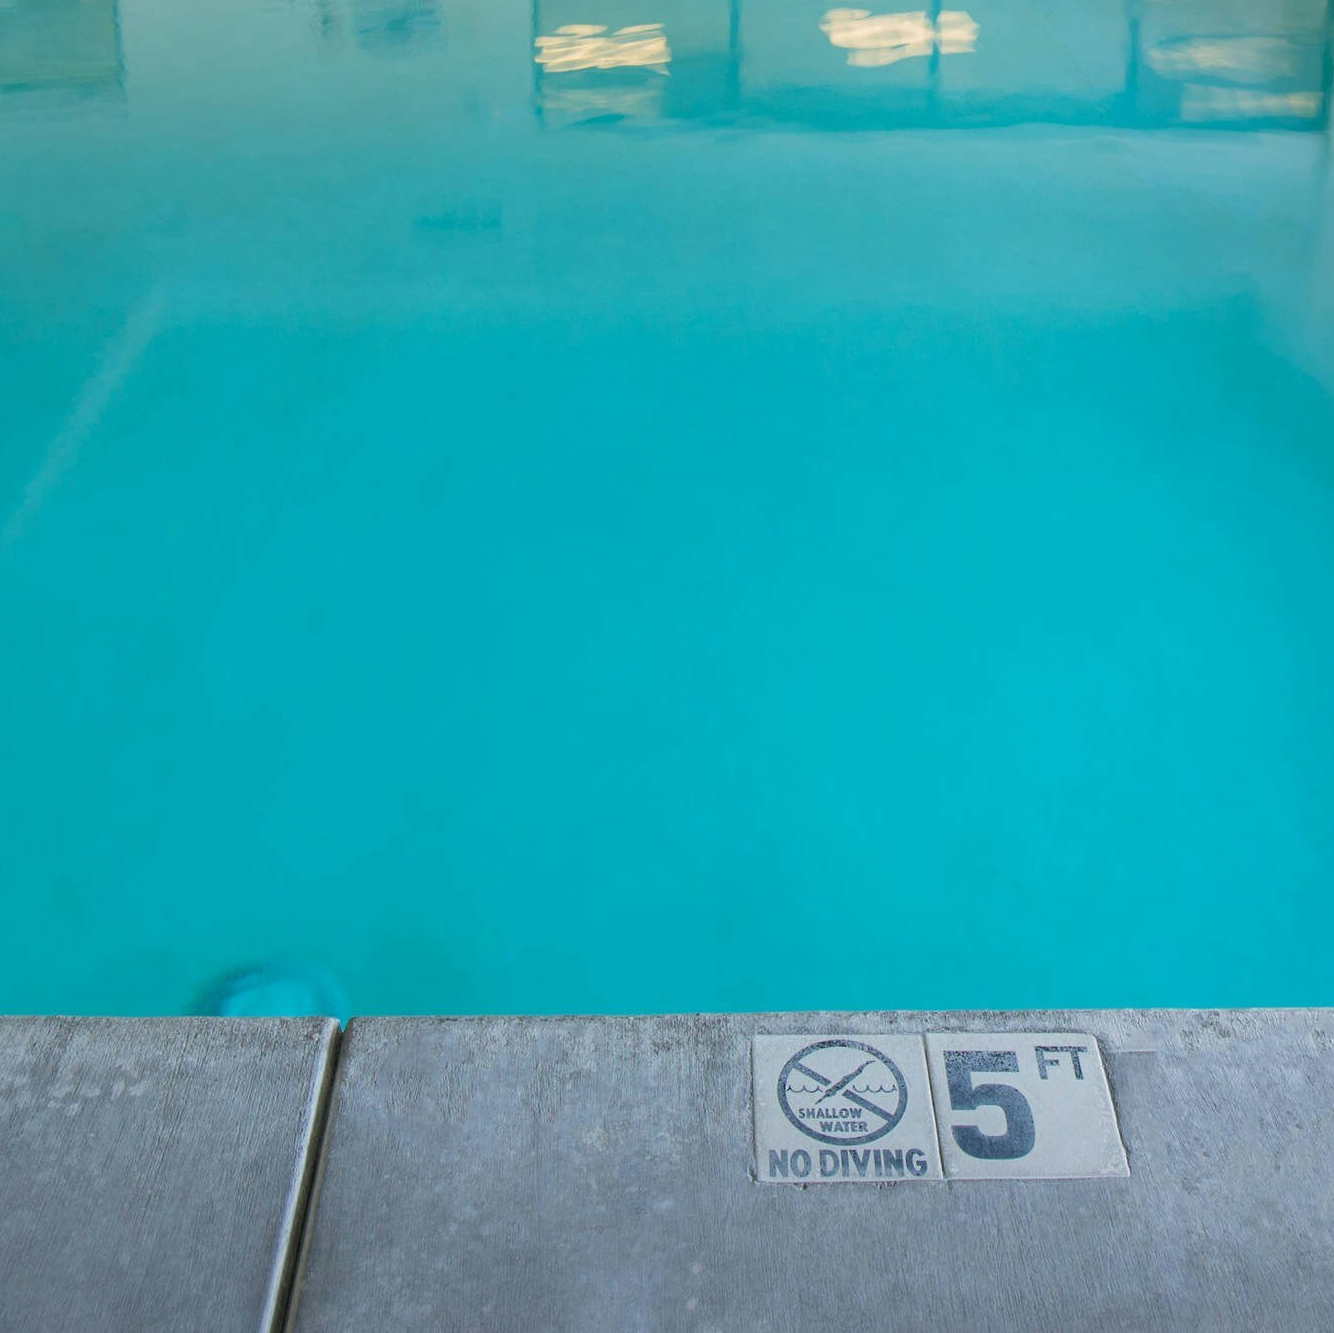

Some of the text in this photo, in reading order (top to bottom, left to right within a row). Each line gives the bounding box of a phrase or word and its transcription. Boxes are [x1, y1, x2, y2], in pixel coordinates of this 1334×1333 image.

[943, 1045, 1088, 1160] 5 FT
[798, 1108, 863, 1119] SHALLOW
[819, 1121, 869, 1133] WATER
[768, 1148, 929, 1178] NO DIVING
